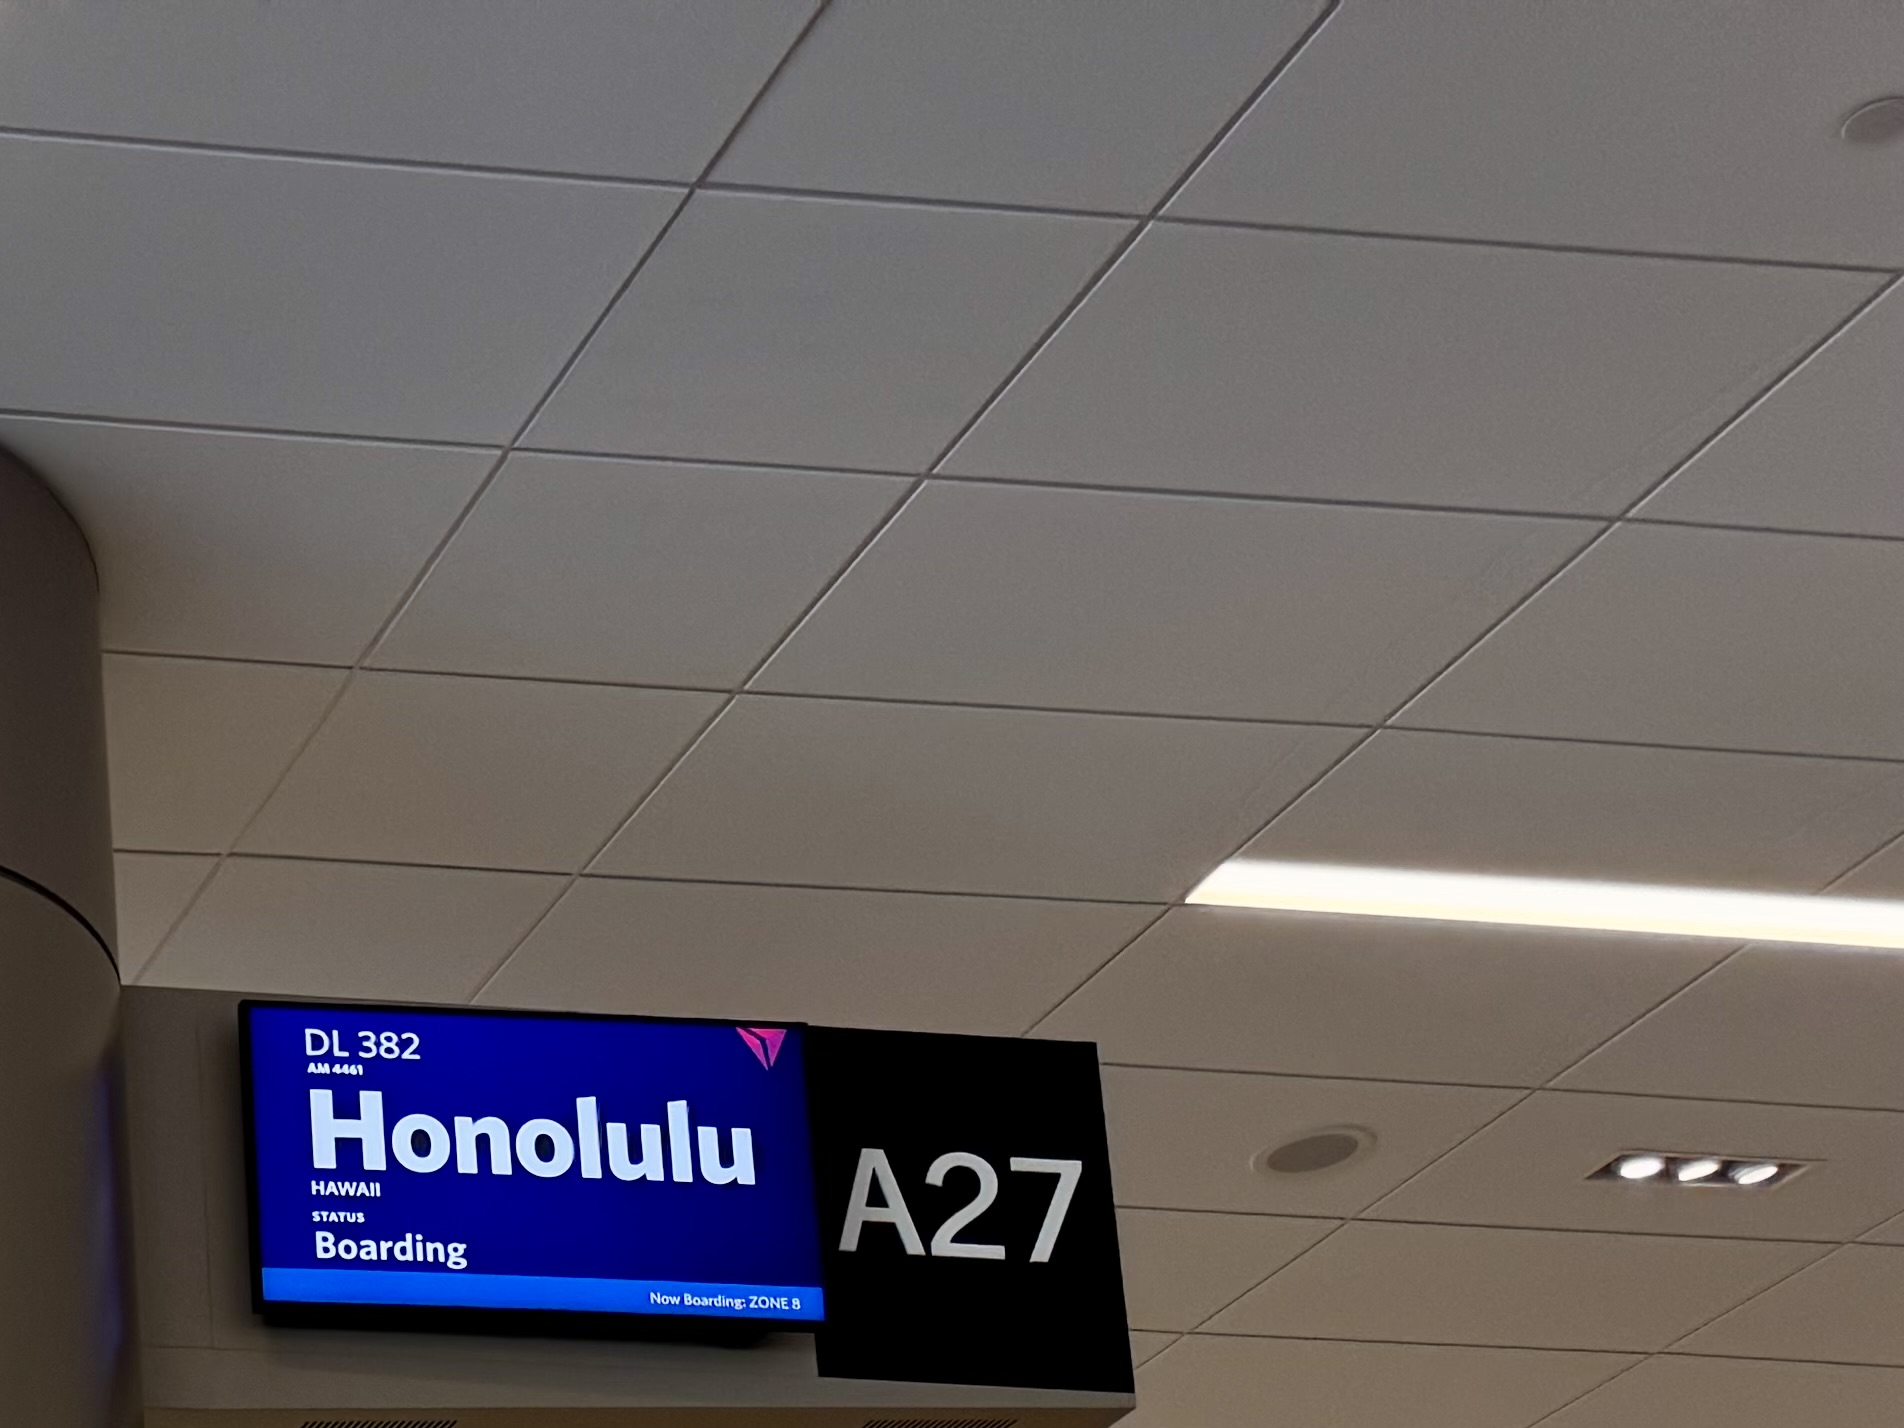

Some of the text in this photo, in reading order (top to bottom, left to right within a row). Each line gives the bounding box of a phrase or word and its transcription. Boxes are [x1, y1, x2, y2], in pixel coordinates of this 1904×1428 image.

[304, 1028, 421, 1060] DL 382
[307, 1062, 331, 1075] AM
[309, 1088, 756, 1186] Honolulu
[310, 1180, 381, 1198] HAWAII
[311, 1210, 366, 1224] STATUS
[838, 1147, 1083, 1264] A27
[315, 1230, 468, 1270] Boarding
[649, 1291, 801, 1311] Now Boarding: ZONE 8
